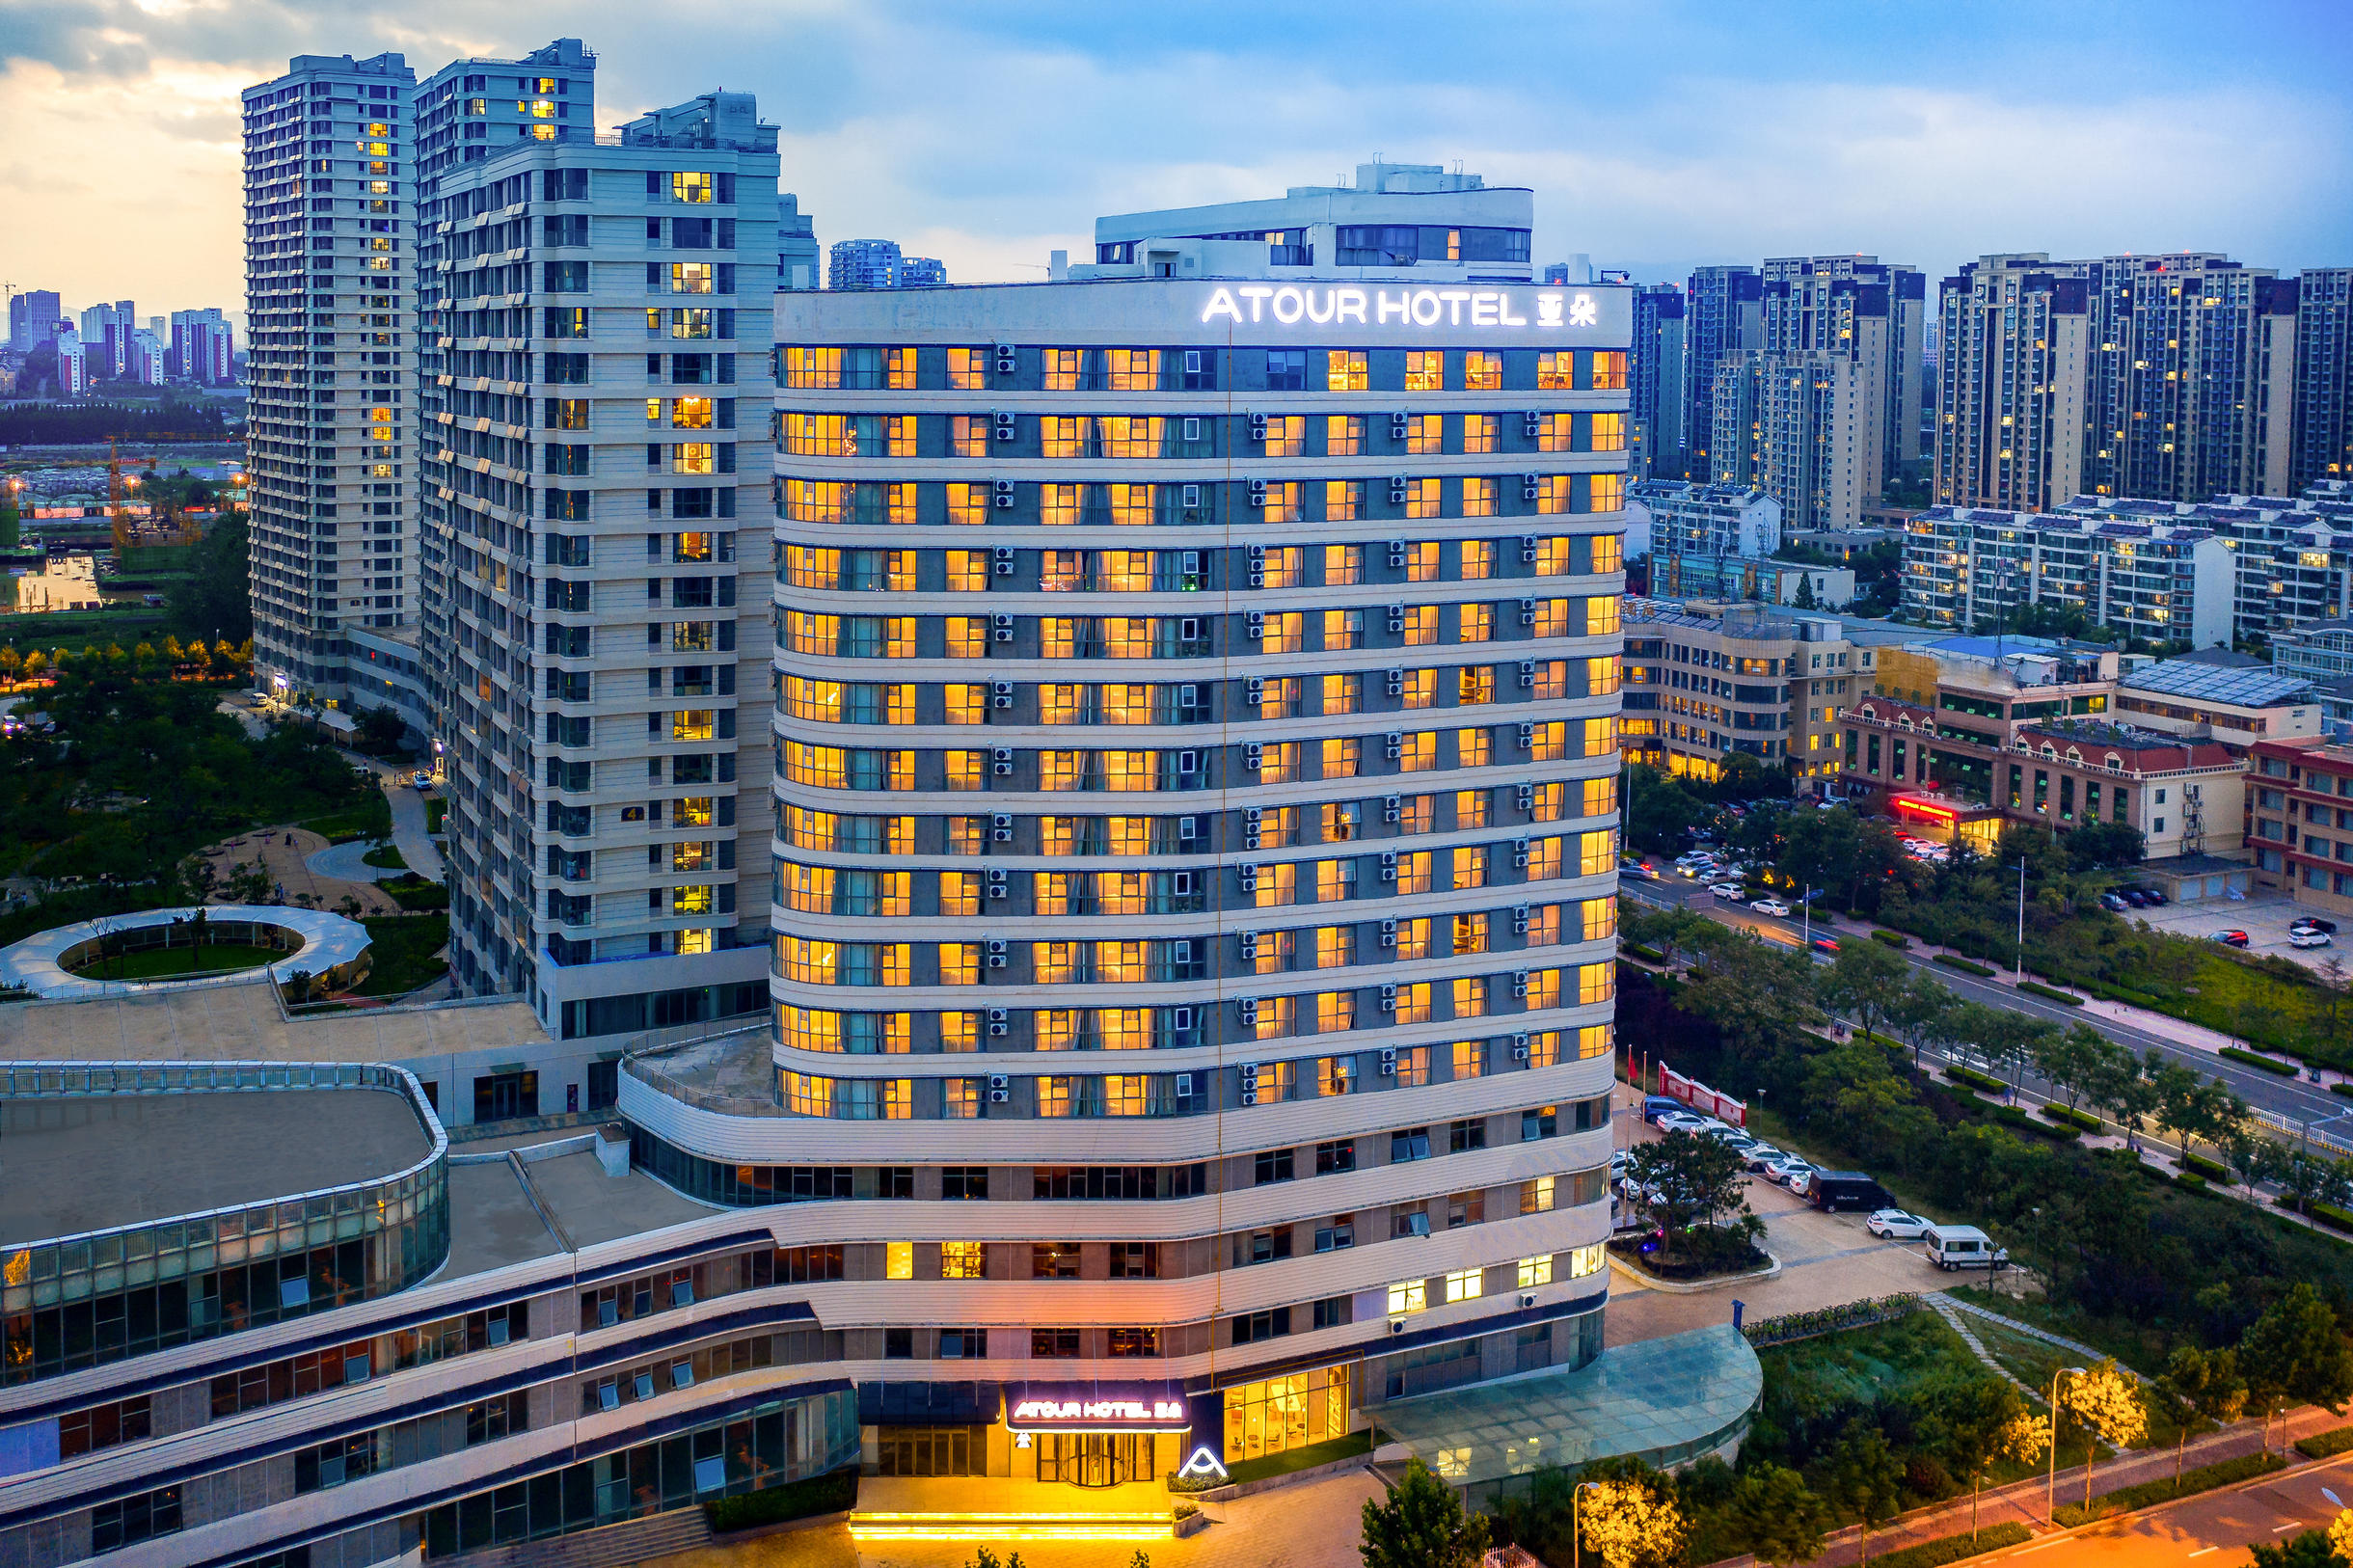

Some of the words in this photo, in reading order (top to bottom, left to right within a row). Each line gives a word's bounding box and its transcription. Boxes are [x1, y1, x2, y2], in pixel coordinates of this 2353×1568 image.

[1202, 286, 1367, 324] ATOUR
[1377, 289, 1527, 327] HOTEL
[1536, 293, 1597, 327] 亚朵
[1014, 1401, 1082, 1419] ATOUR
[1083, 1401, 1152, 1419] HOTEL
